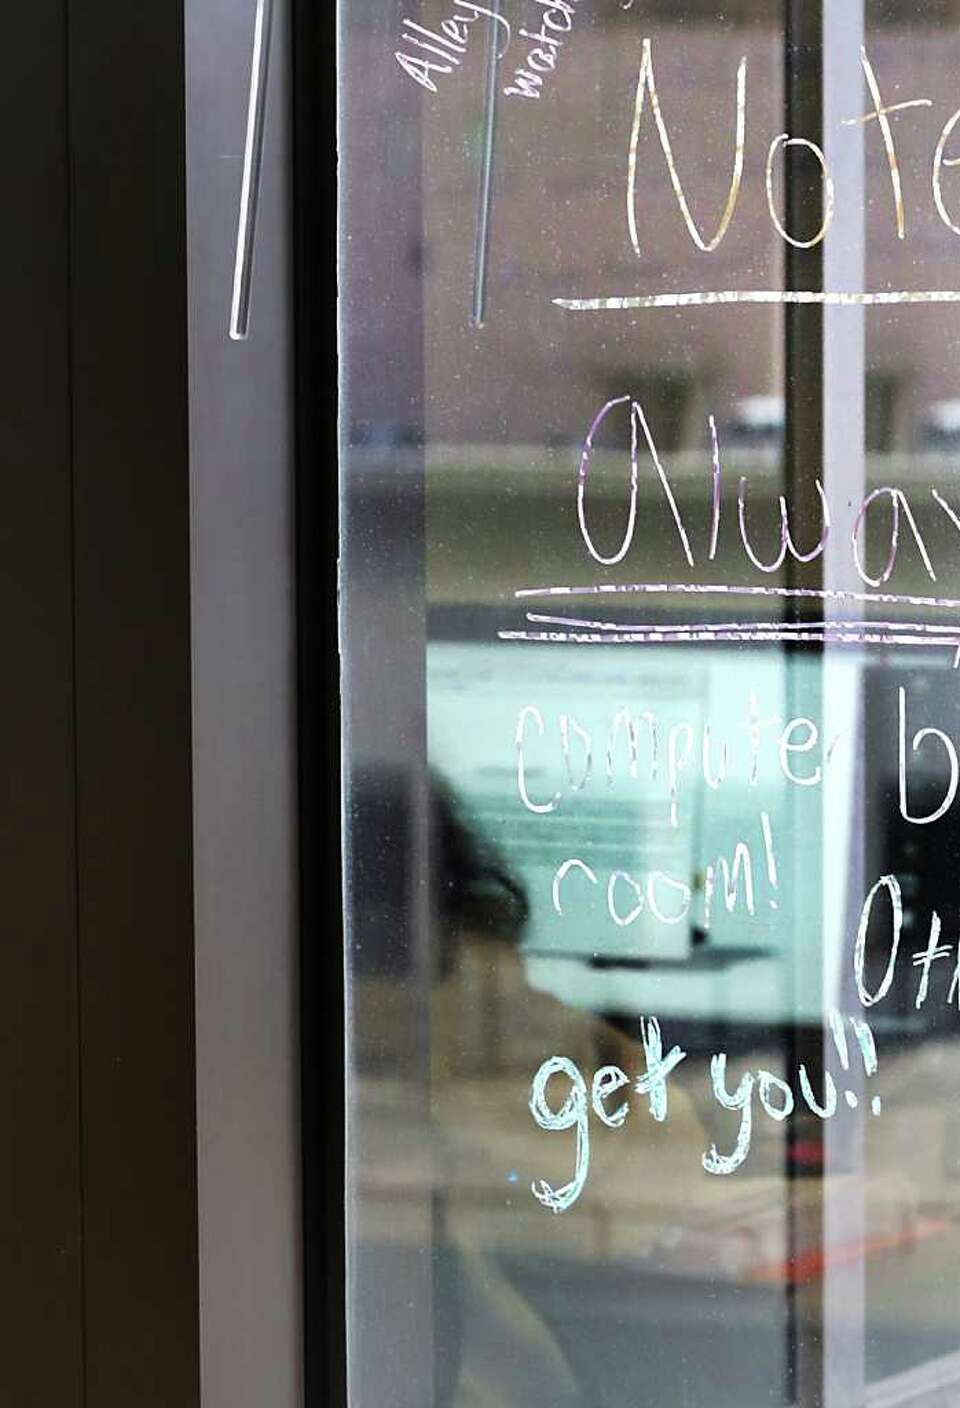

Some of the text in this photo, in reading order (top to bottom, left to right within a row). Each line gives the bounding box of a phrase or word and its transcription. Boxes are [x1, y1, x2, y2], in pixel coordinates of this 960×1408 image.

[394, 0, 511, 92] Alley
[552, 811, 779, 929] room!
[528, 1008, 882, 1213] get you!!
